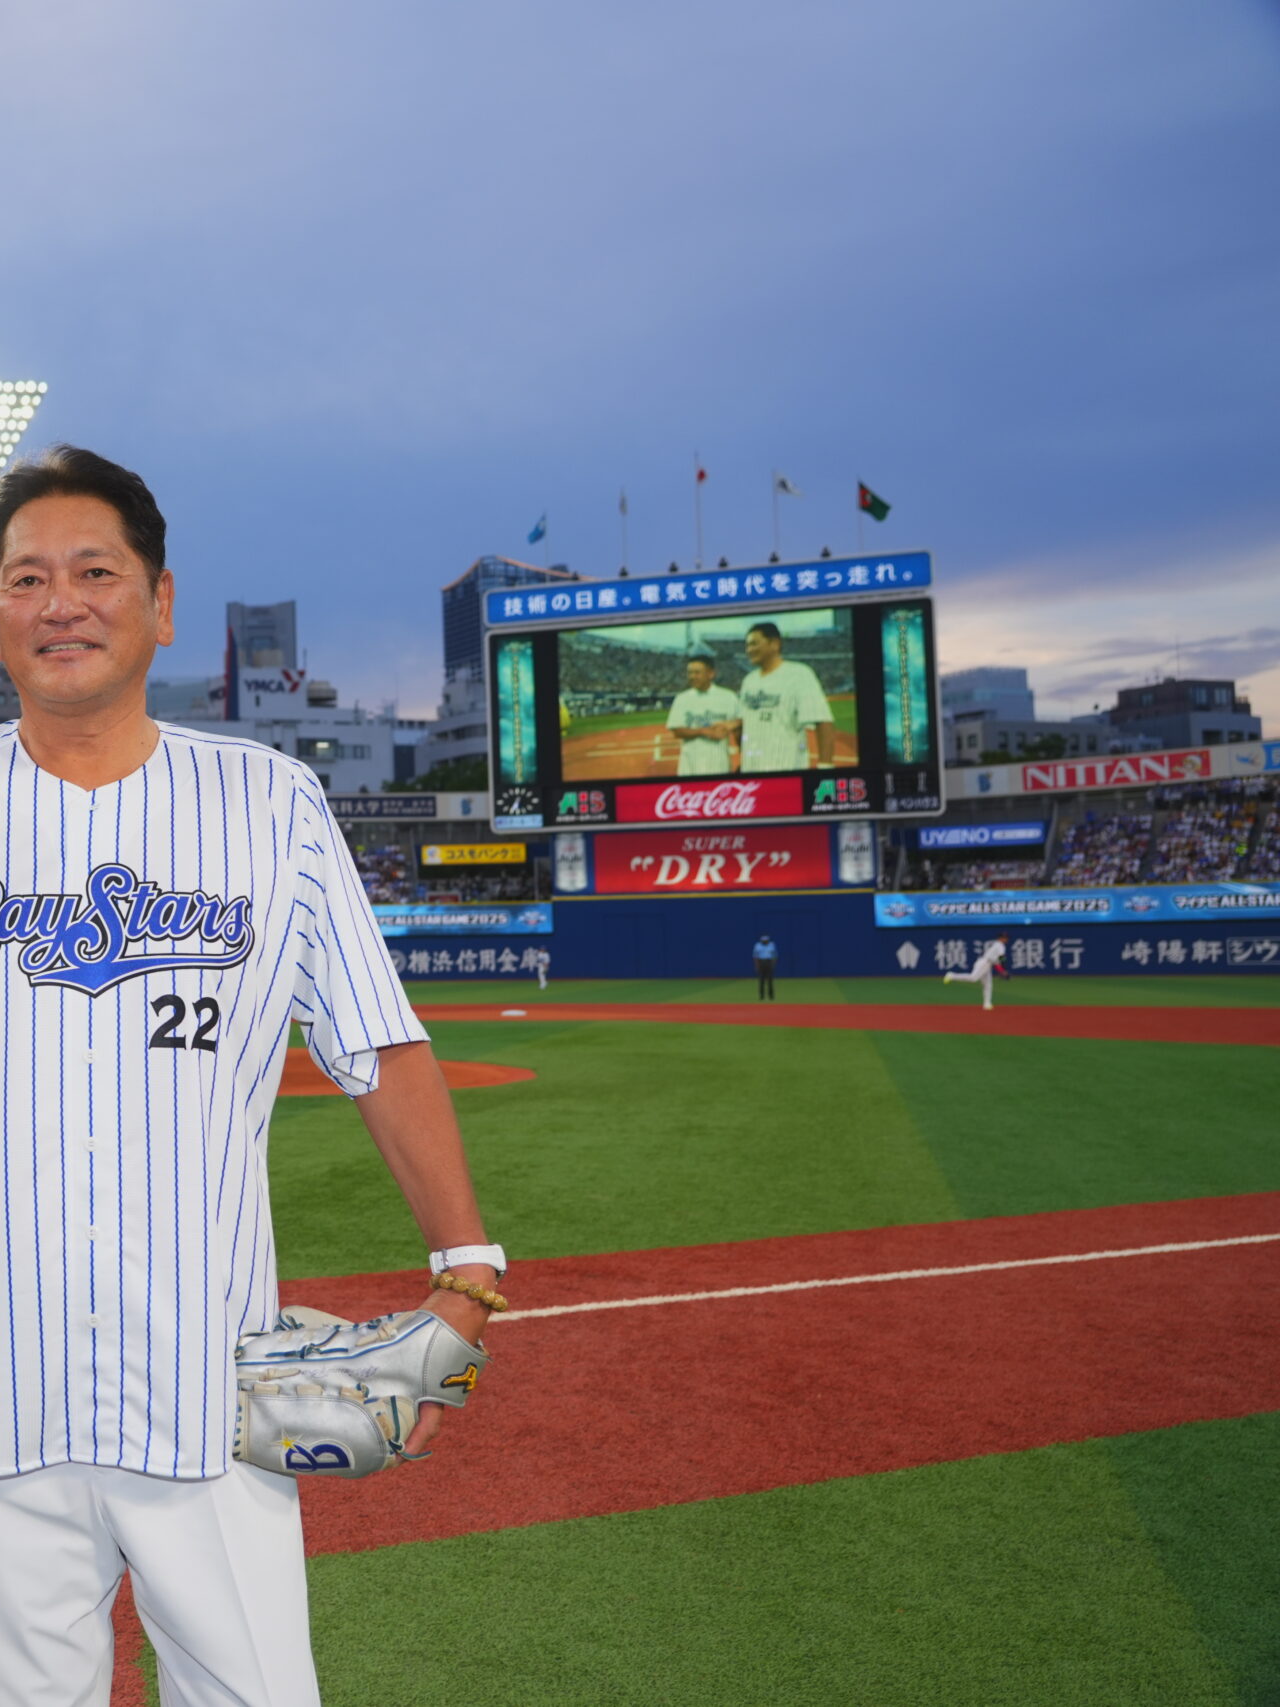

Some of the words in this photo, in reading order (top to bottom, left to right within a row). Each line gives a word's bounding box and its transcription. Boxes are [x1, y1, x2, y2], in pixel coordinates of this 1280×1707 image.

[503, 561, 914, 618] 技術の日産。電気で時代を突っ走れ。
[244, 679, 286, 693] YMCA
[1026, 755, 1170, 790] NITTAN
[655, 781, 762, 819] Coca-Cola
[681, 835, 747, 851] SUPER
[407, 946, 540, 974] 横浜信用金庫
[1121, 938, 1223, 966] 崎陽軒
[148, 993, 221, 1054] 22
